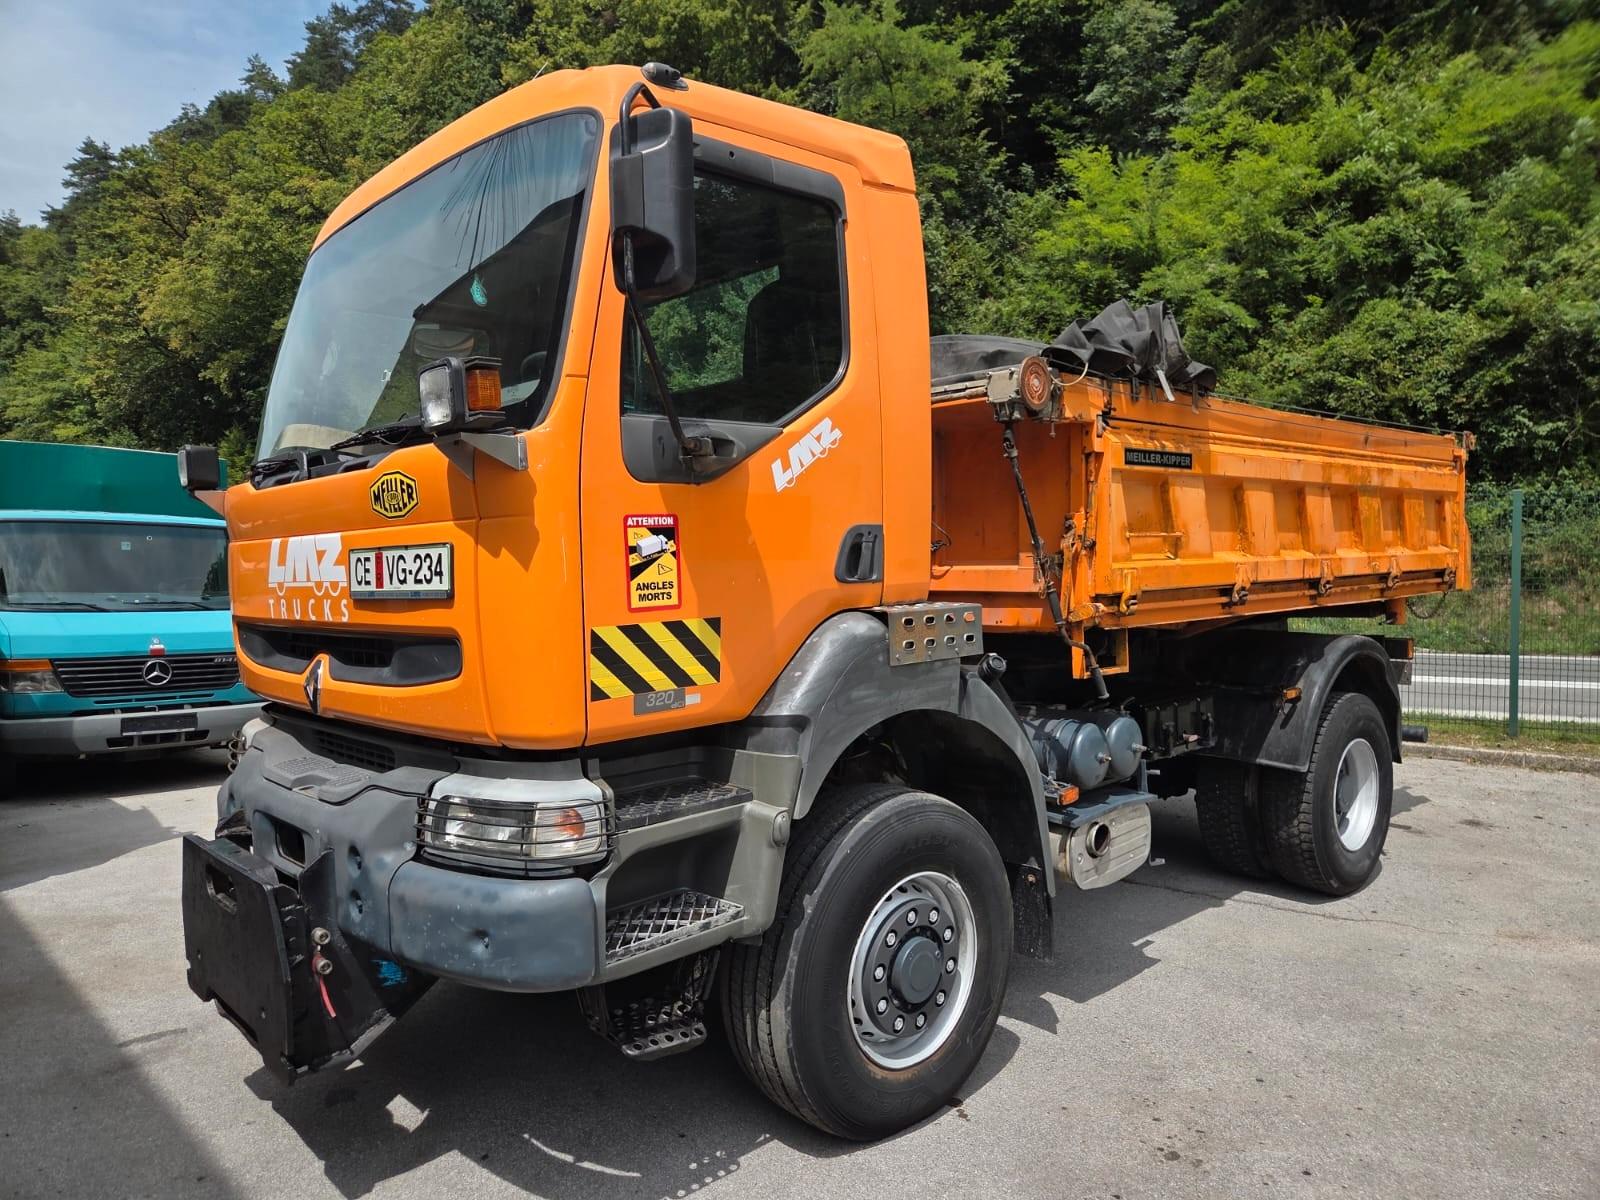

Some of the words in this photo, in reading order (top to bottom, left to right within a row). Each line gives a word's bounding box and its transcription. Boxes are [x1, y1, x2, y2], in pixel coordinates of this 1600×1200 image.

[771, 417, 843, 492] LMZ
[1126, 451, 1191, 466] MEILLER-KIPPER
[373, 477, 414, 513] MEILLER
[627, 516, 674, 527] ATTENTION
[268, 533, 347, 584] LMZ
[355, 557, 371, 585] CE
[386, 553, 444, 585] VG-234
[635, 581, 674, 592] ANGLES
[638, 592, 672, 602] MORTS
[269, 599, 349, 622] TRUCKS
[646, 690, 674, 706] 320
